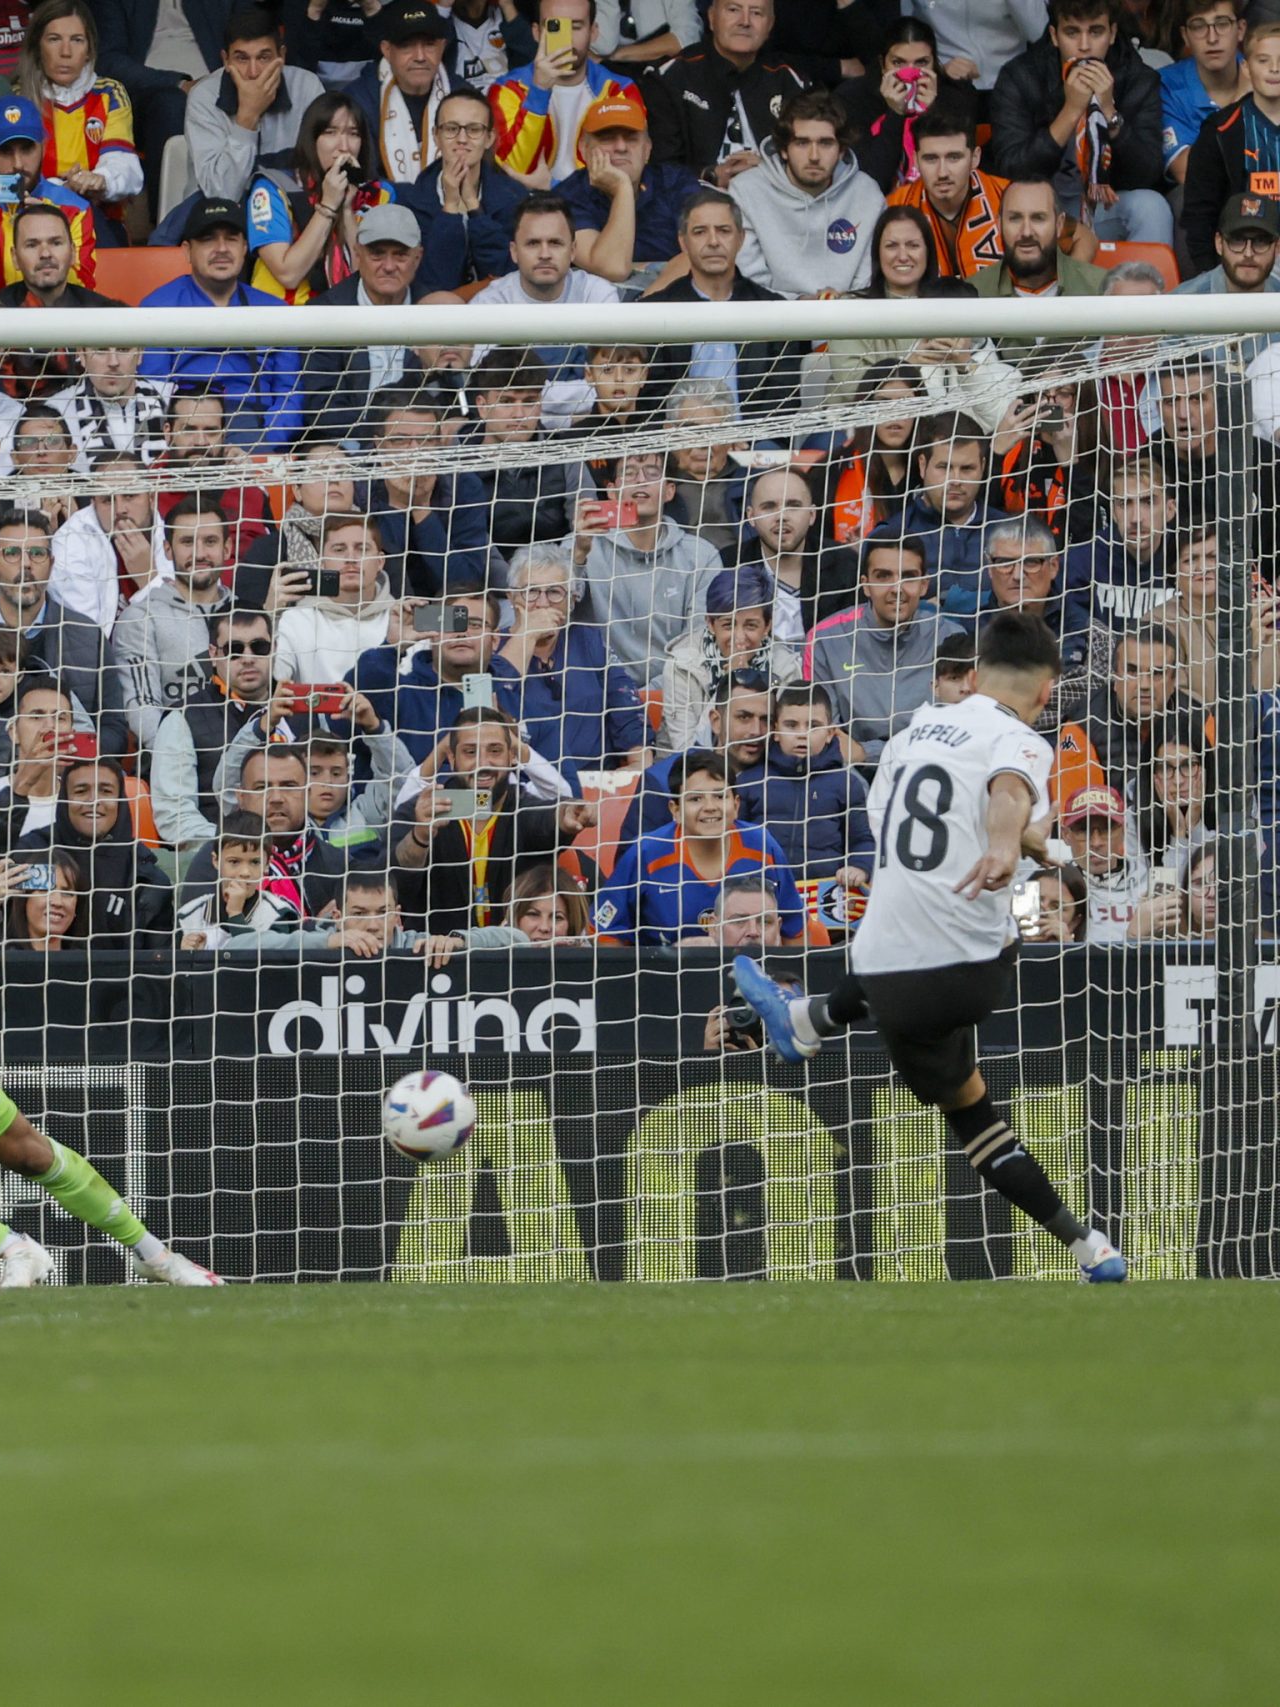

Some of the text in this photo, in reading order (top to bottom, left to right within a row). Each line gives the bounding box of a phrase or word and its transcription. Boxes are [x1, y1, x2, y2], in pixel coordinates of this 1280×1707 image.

[1254, 178, 1274, 190] TM
[828, 231, 856, 241] NASA
[908, 724, 973, 749] PEPELU
[878, 765, 953, 872] 18
[267, 974, 597, 1055] divina
